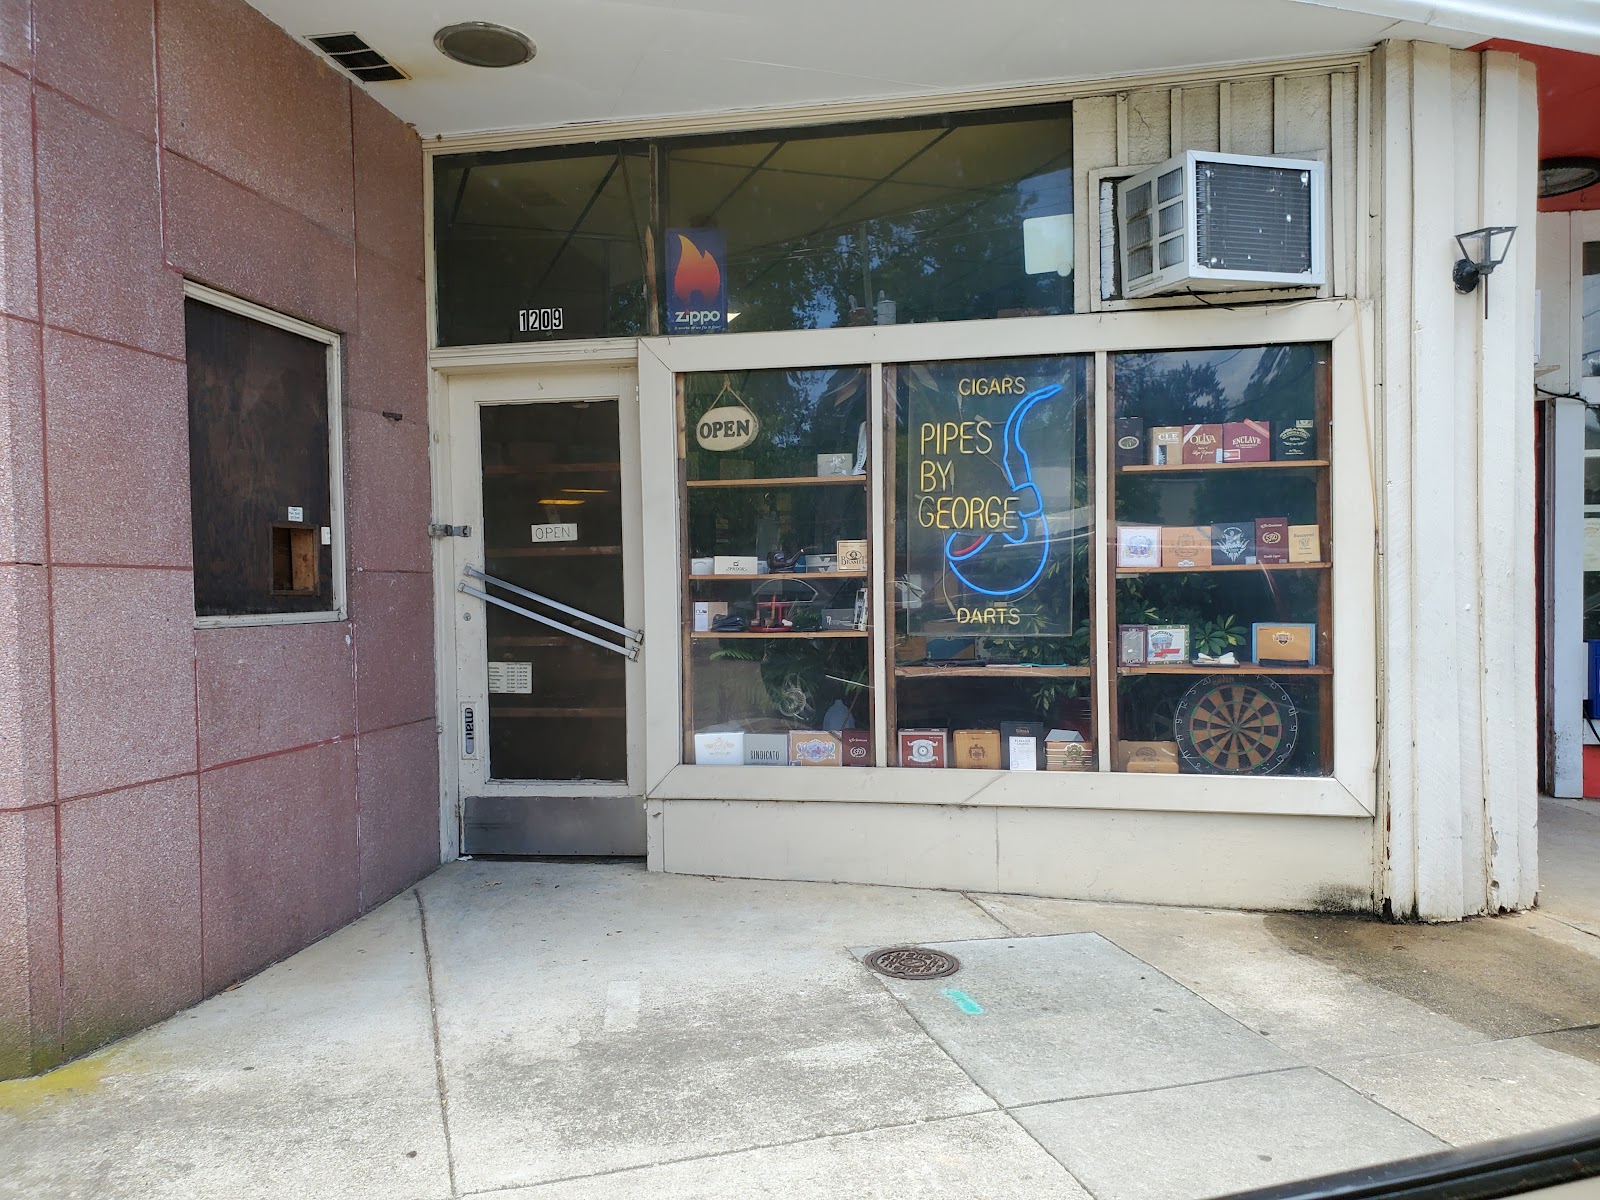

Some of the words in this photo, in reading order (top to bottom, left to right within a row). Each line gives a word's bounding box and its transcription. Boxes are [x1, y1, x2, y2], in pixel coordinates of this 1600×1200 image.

[520, 309, 562, 331] 1209
[958, 376, 1026, 396] CIGARS
[700, 419, 750, 439] OPEN
[920, 420, 993, 456] PIPES
[1232, 435, 1262, 445] ENCLAVE
[920, 459, 953, 493] BY
[918, 495, 1021, 529] GEORGE
[535, 526, 571, 540] OPEN
[956, 607, 1021, 625] DARTS
[465, 711, 474, 740] mail
[750, 750, 780, 761] SINDICATO
